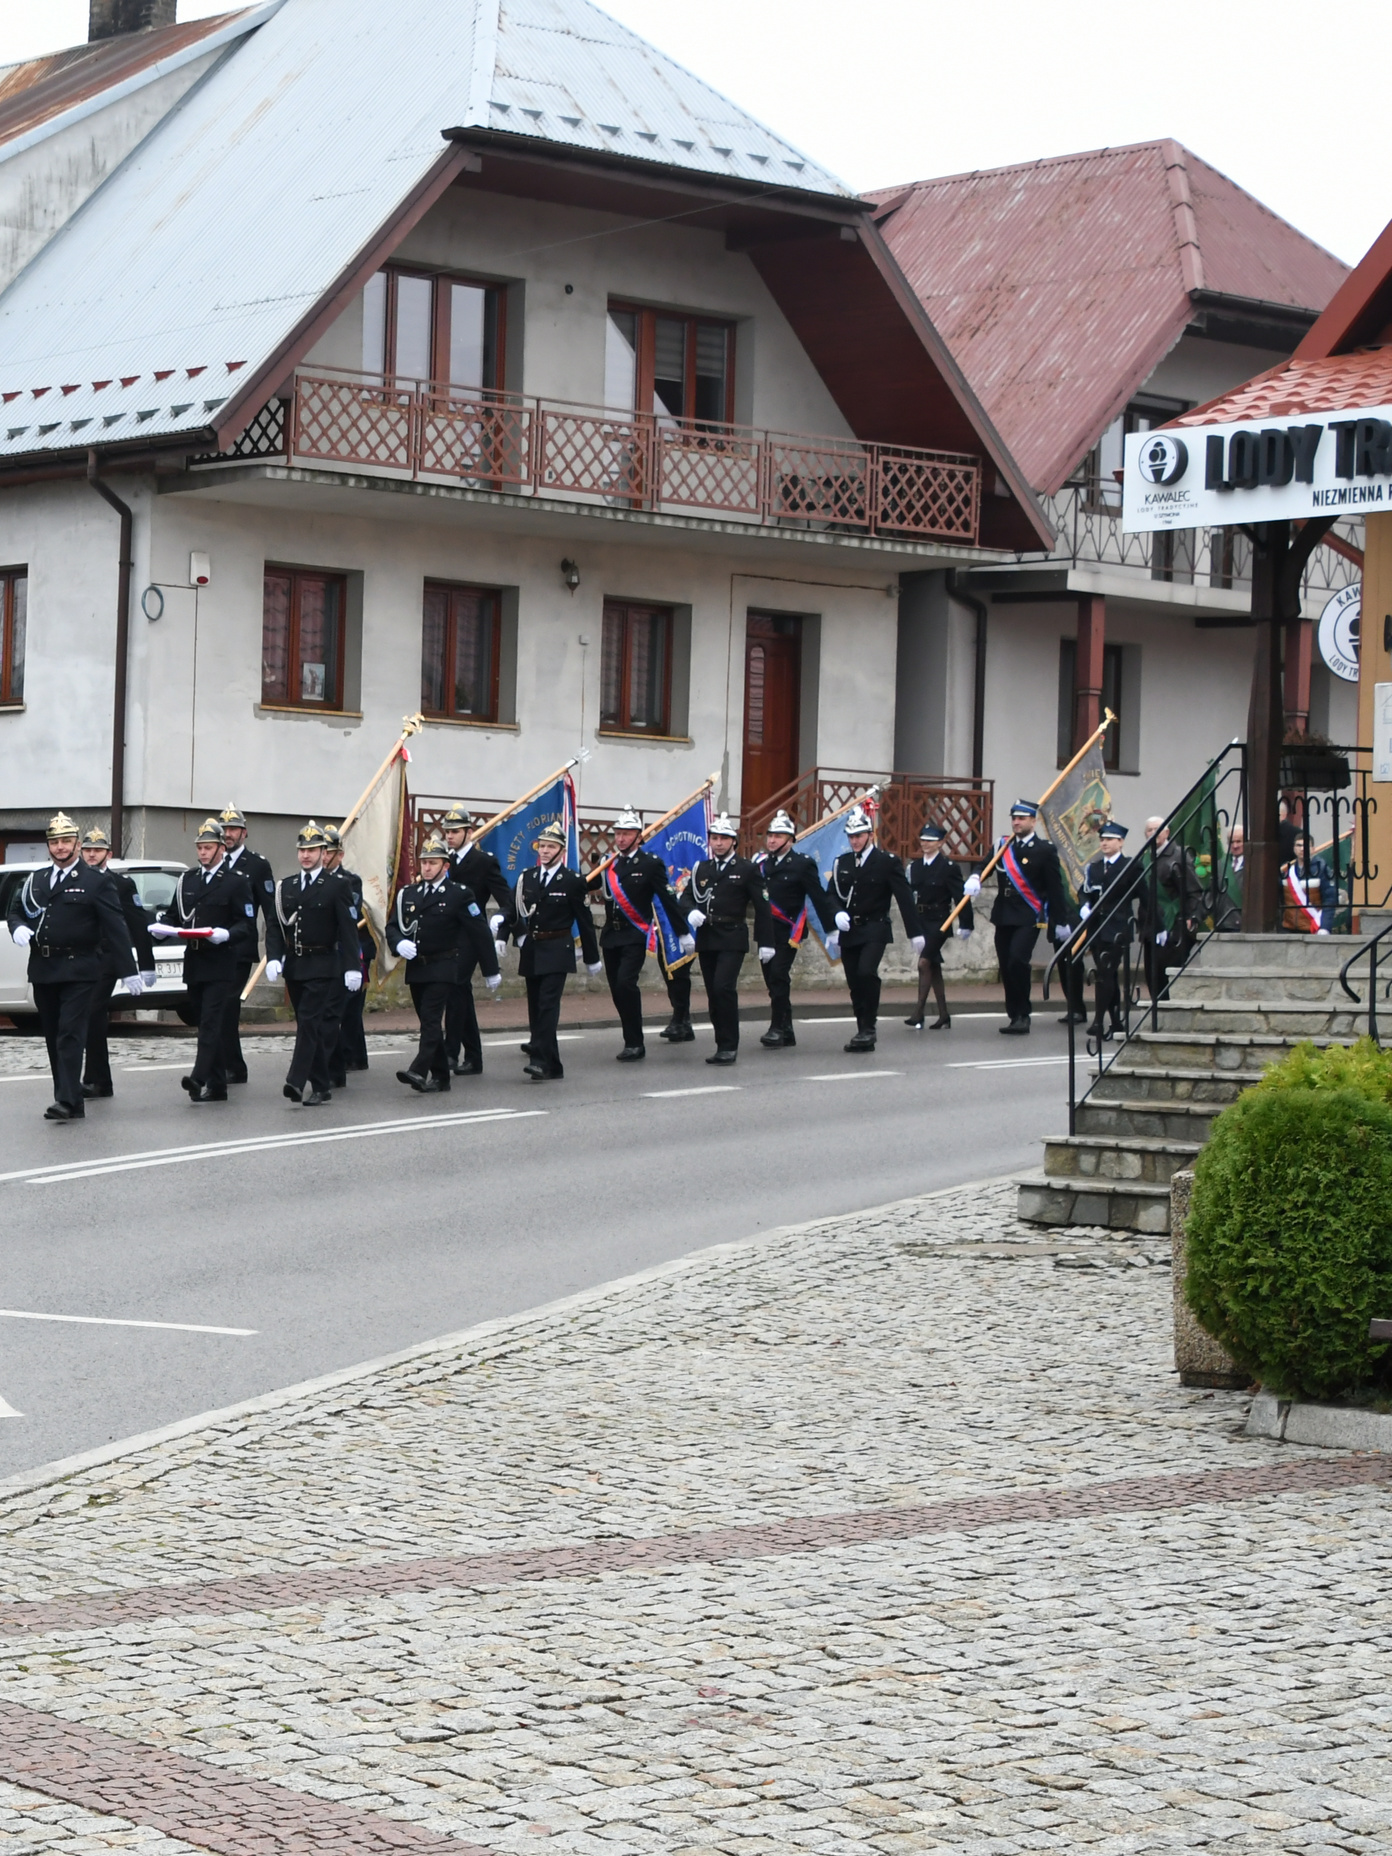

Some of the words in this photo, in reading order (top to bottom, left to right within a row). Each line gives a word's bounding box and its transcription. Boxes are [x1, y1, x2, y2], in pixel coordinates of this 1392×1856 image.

[1205, 424, 1324, 492] LODY
[1328, 417, 1392, 480] TR
[1144, 490, 1191, 505] KAWALEC
[1312, 484, 1383, 507] NIEZMIENNA
[1328, 654, 1348, 674] LODY
